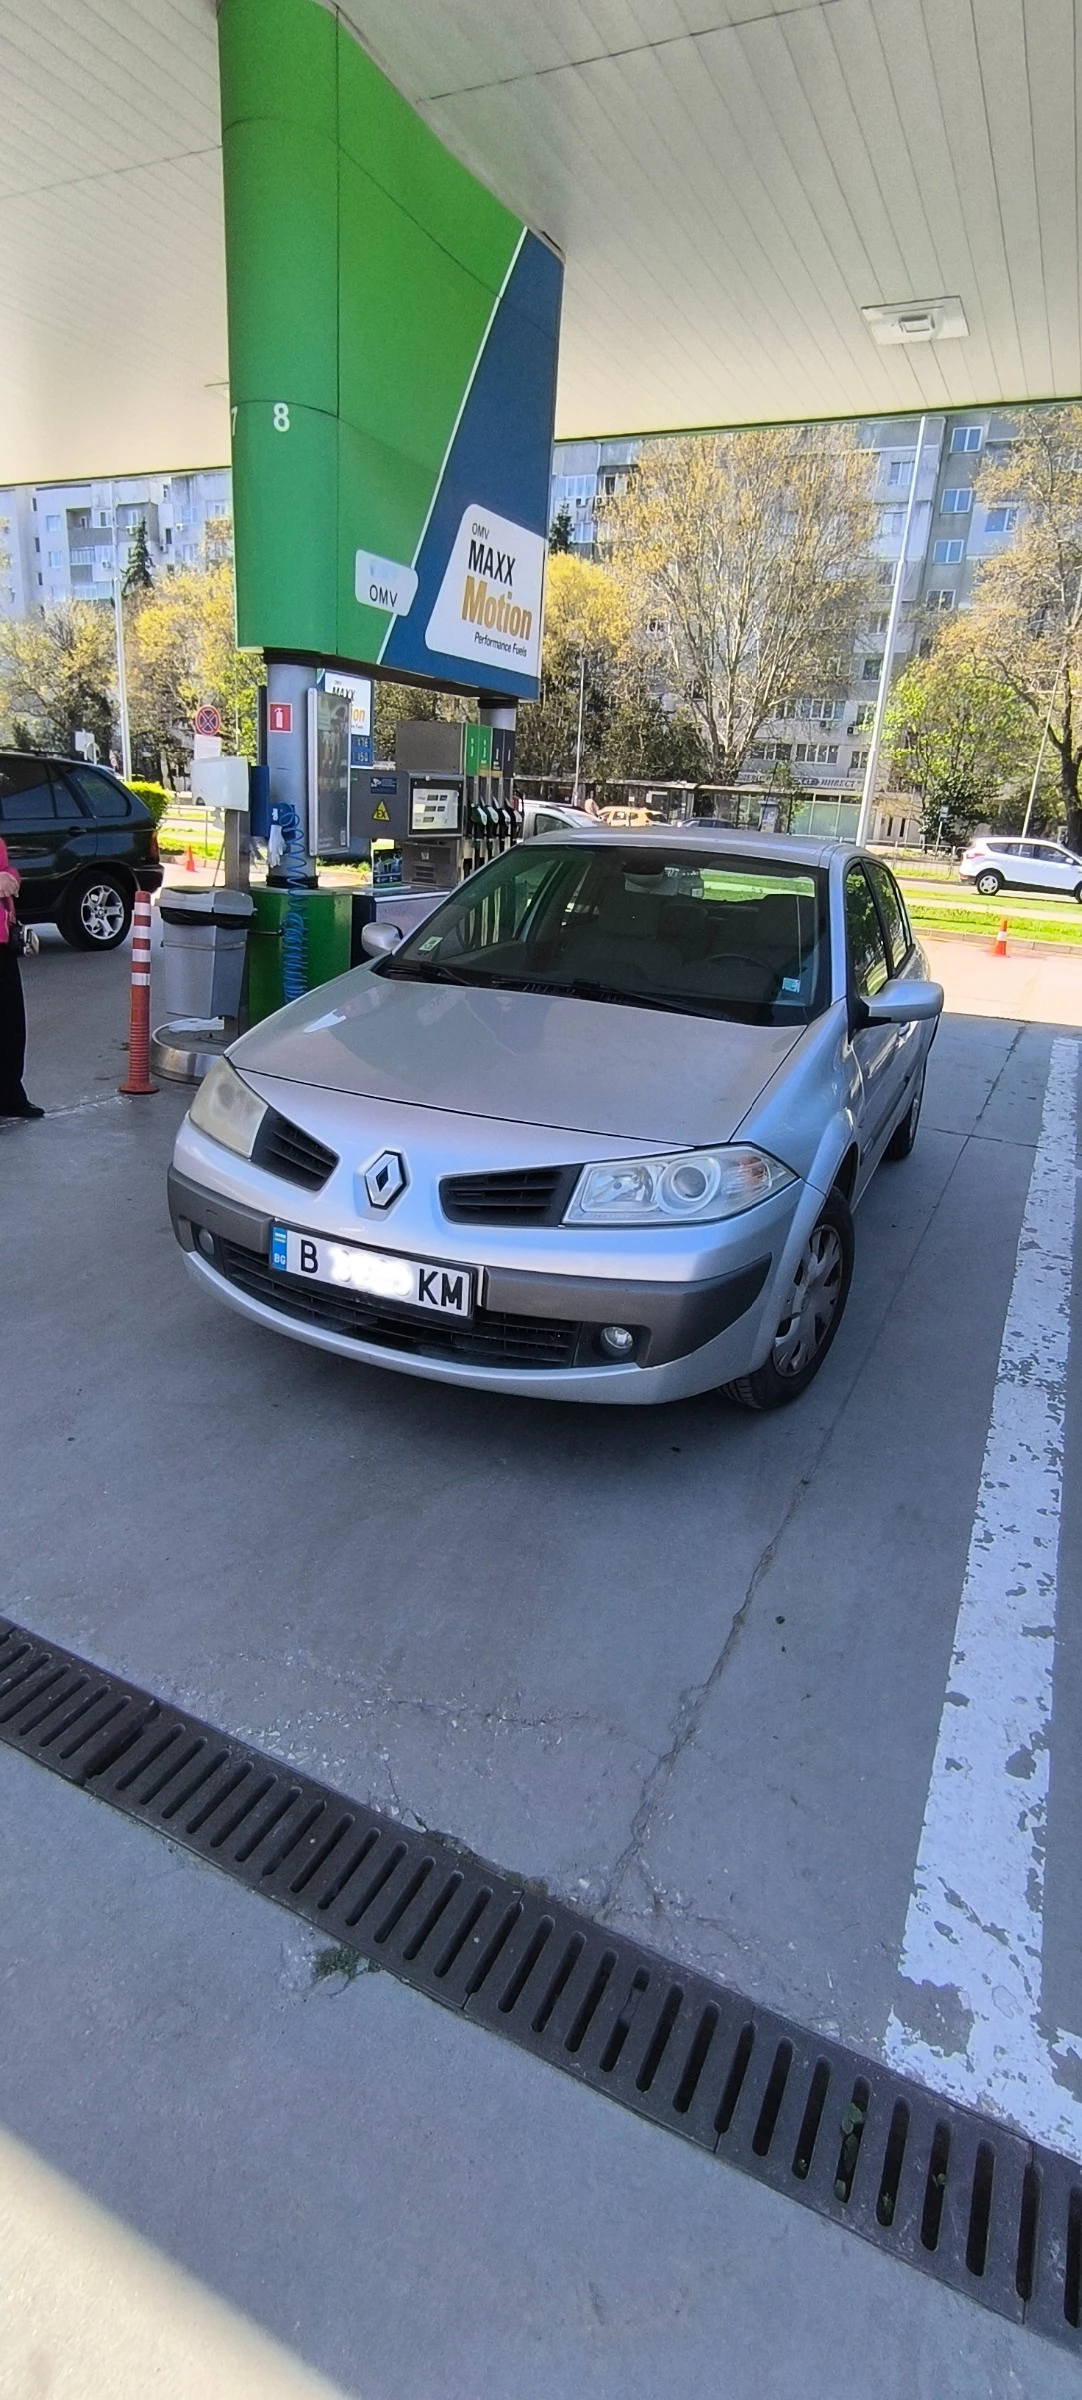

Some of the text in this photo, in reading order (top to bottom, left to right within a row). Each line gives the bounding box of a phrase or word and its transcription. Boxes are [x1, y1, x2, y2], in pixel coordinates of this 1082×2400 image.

[273, 402, 290, 432] 8
[471, 522, 490, 540] OMV
[467, 539, 516, 586] MAXX
[369, 584, 398, 607] OMV
[461, 575, 533, 641] Motion
[474, 631, 528, 657] Performance Fuels
[377, 809, 387, 818] EX
[274, 1252, 286, 1266] BG
[300, 1239, 319, 1274] B
[418, 1268, 464, 1311] KM
